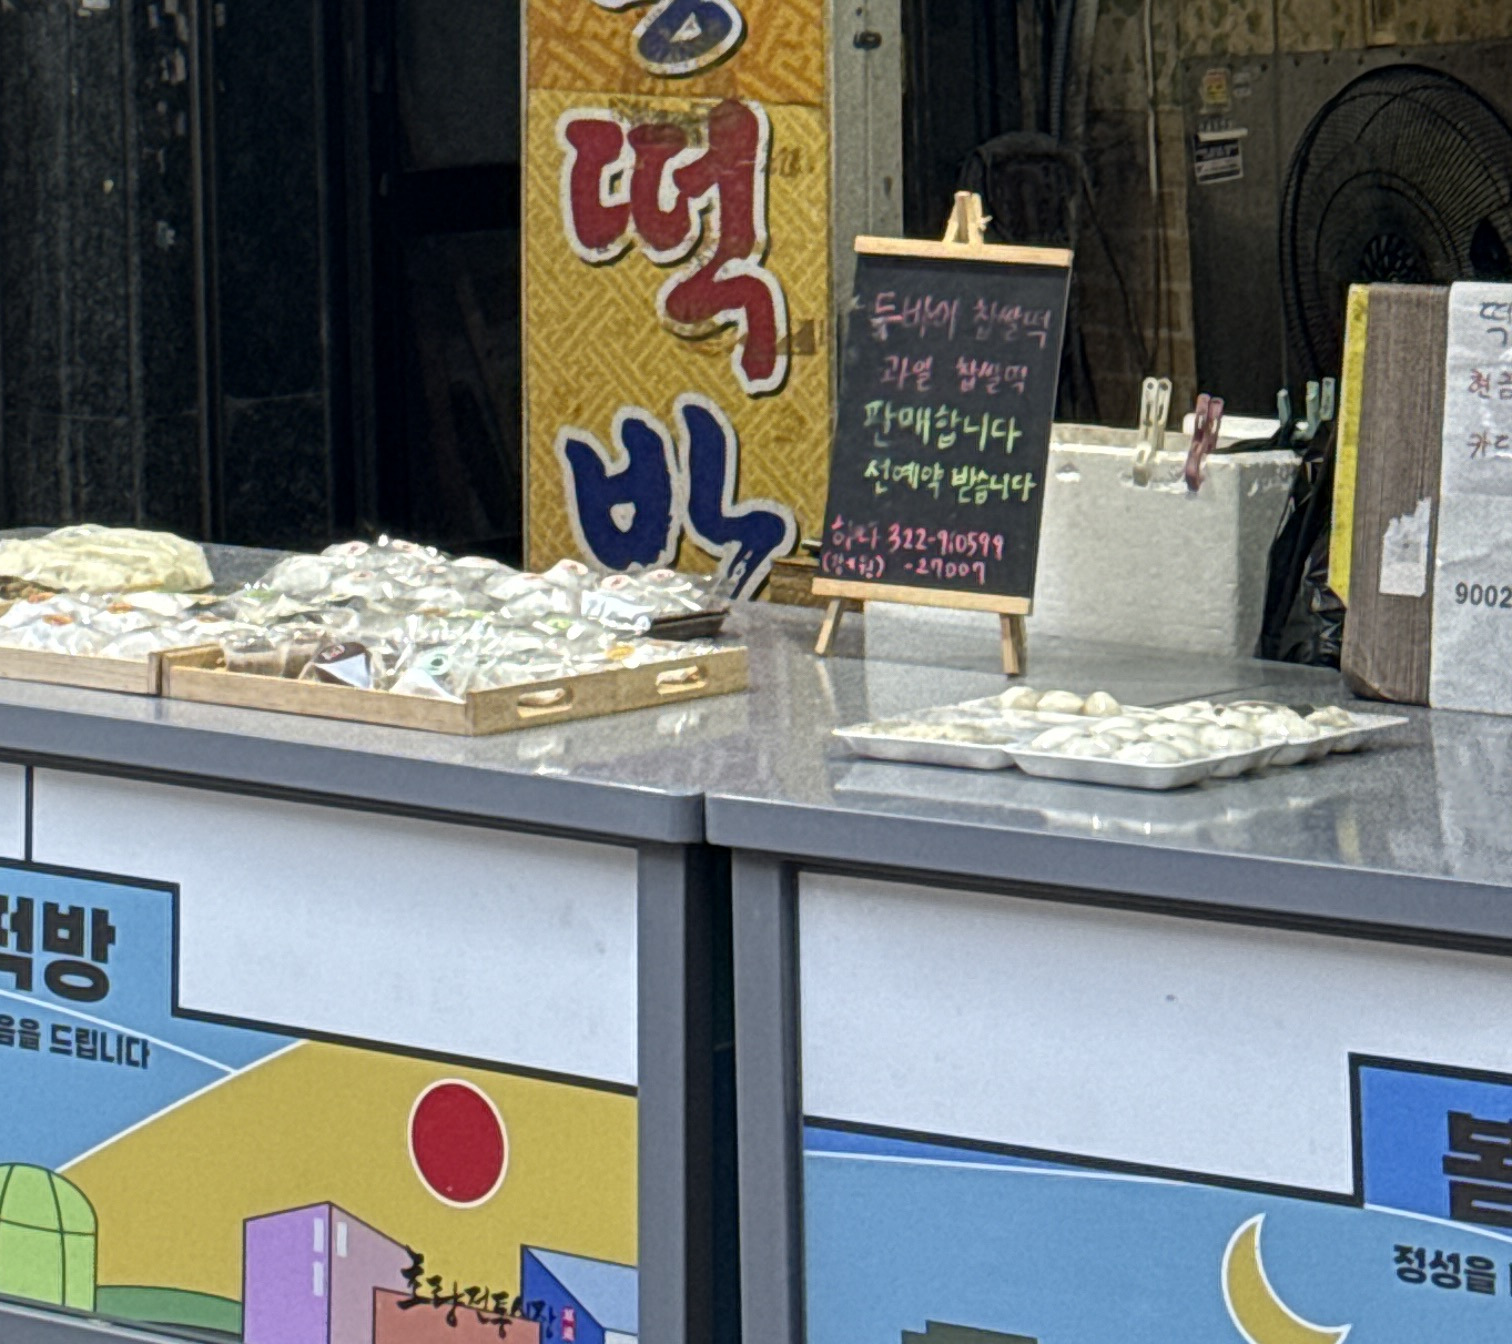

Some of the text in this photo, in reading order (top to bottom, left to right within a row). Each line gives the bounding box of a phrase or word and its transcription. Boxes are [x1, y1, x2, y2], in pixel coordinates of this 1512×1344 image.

[863, 398, 1022, 454] 판매합니다
[864, 459, 1037, 505] 선예약 받습니다
[49, 1023, 151, 1070] 드립니다
[1393, 1244, 1497, 1295] 정성을
